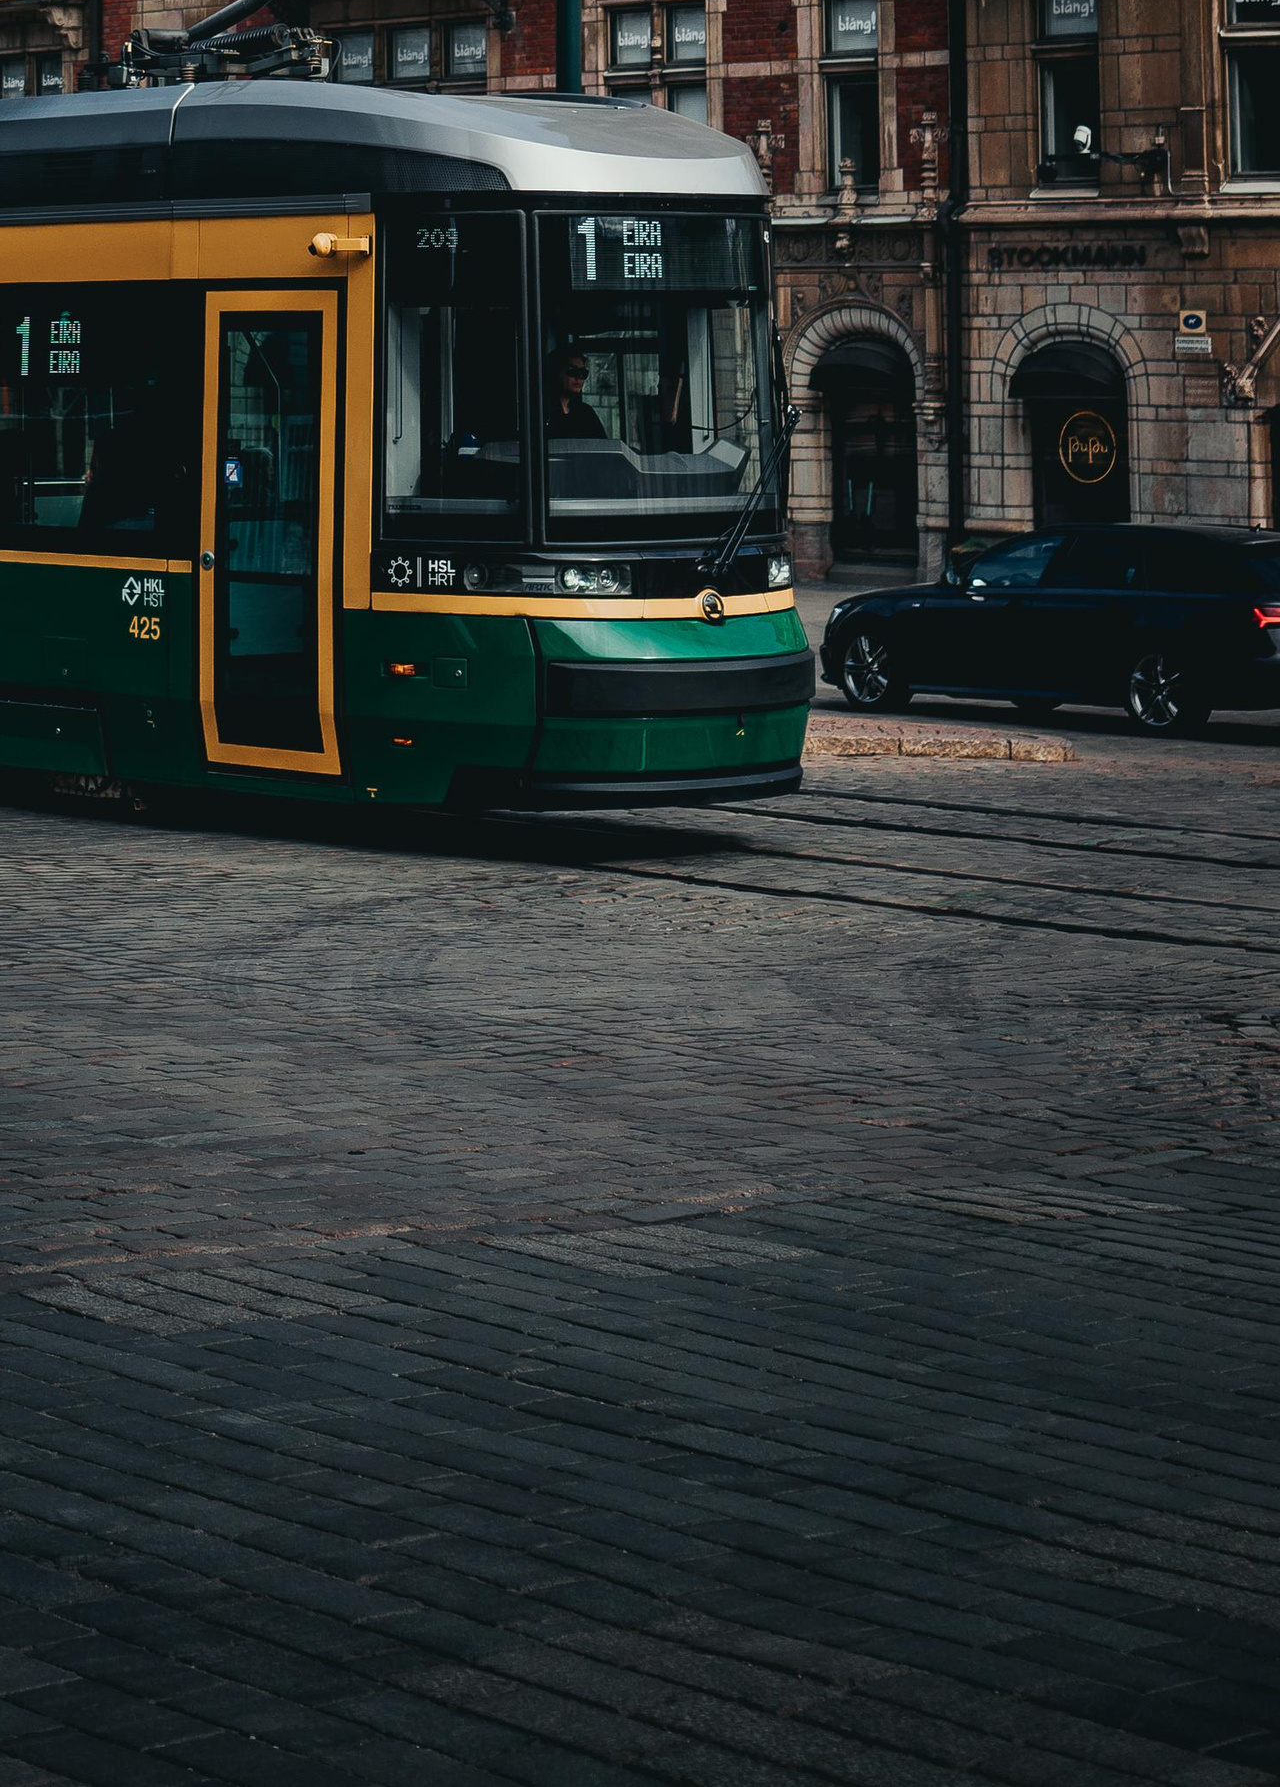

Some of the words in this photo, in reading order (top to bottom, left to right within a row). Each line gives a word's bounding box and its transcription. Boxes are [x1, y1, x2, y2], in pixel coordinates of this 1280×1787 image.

[838, 10, 877, 34] biáng!
[342, 47, 372, 68] biáng!
[397, 43, 428, 64] biáng!
[454, 38, 486, 59] biáng!
[417, 228, 458, 247] 209
[622, 221, 662, 246] EIRA
[577, 217, 597, 281] 1
[623, 253, 663, 278] EIRA
[50, 321, 81, 344] EIRA
[16, 316, 30, 376] 1
[49, 351, 80, 374] EIRA
[428, 559, 456, 573] HSL
[144, 578, 165, 593] HKL
[428, 573, 456, 586] HRT
[144, 593, 165, 607] HST
[129, 615, 161, 640] 425
